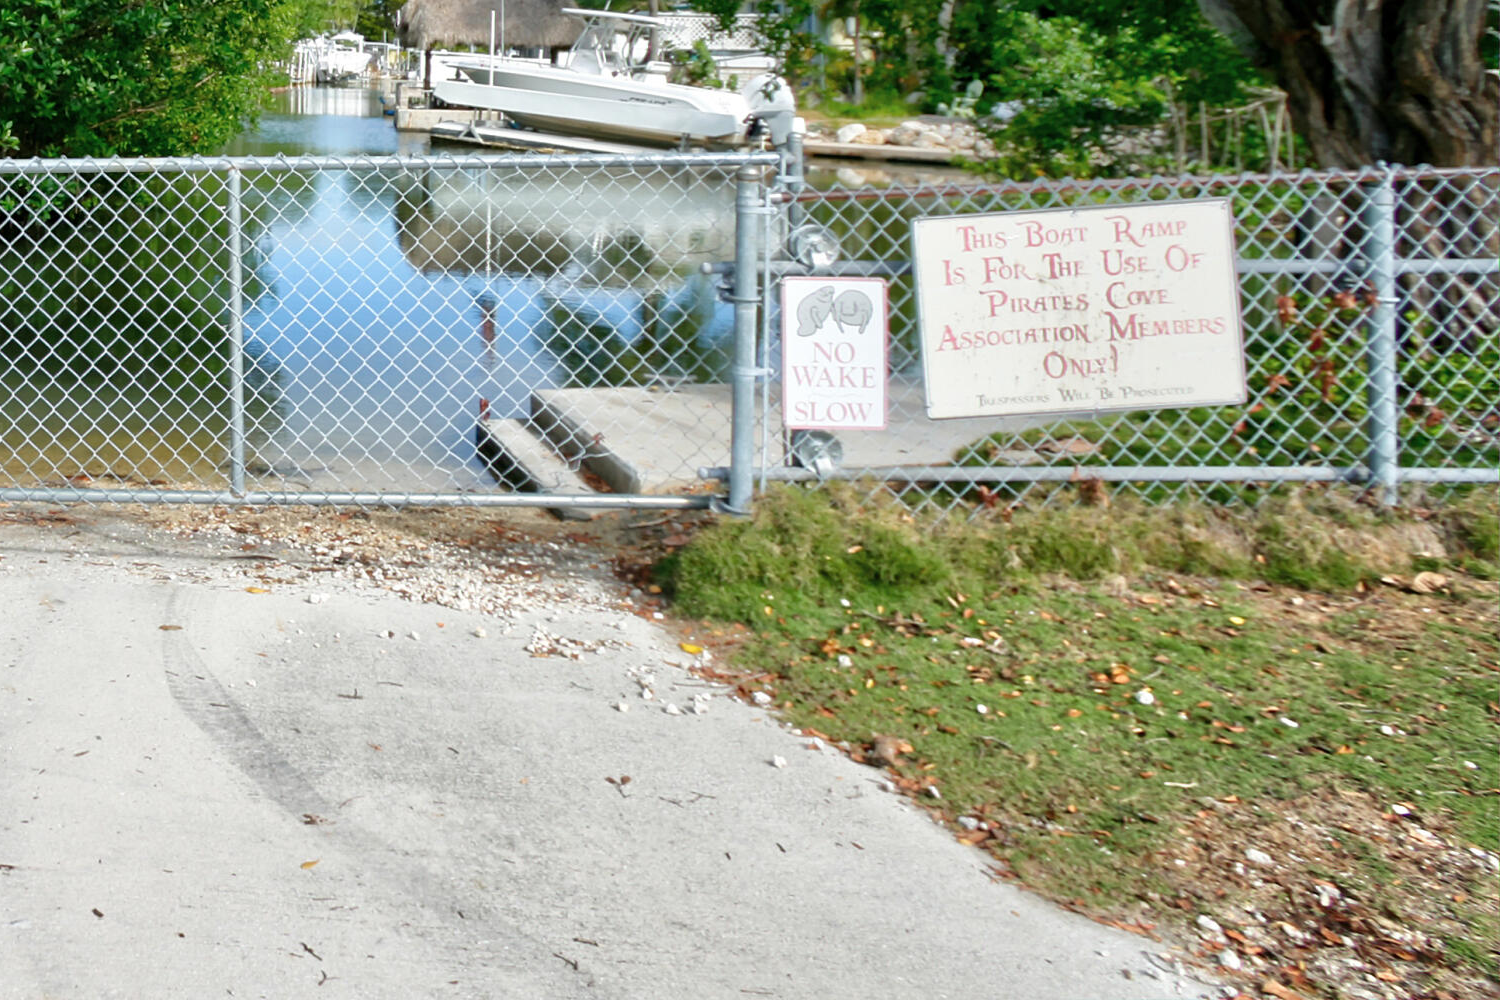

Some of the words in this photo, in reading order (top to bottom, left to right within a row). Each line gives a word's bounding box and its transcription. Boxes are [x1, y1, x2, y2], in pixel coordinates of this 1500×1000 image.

[812, 341, 855, 364] NO
[792, 366, 877, 389] WAKE
[794, 401, 874, 423] SLOW
